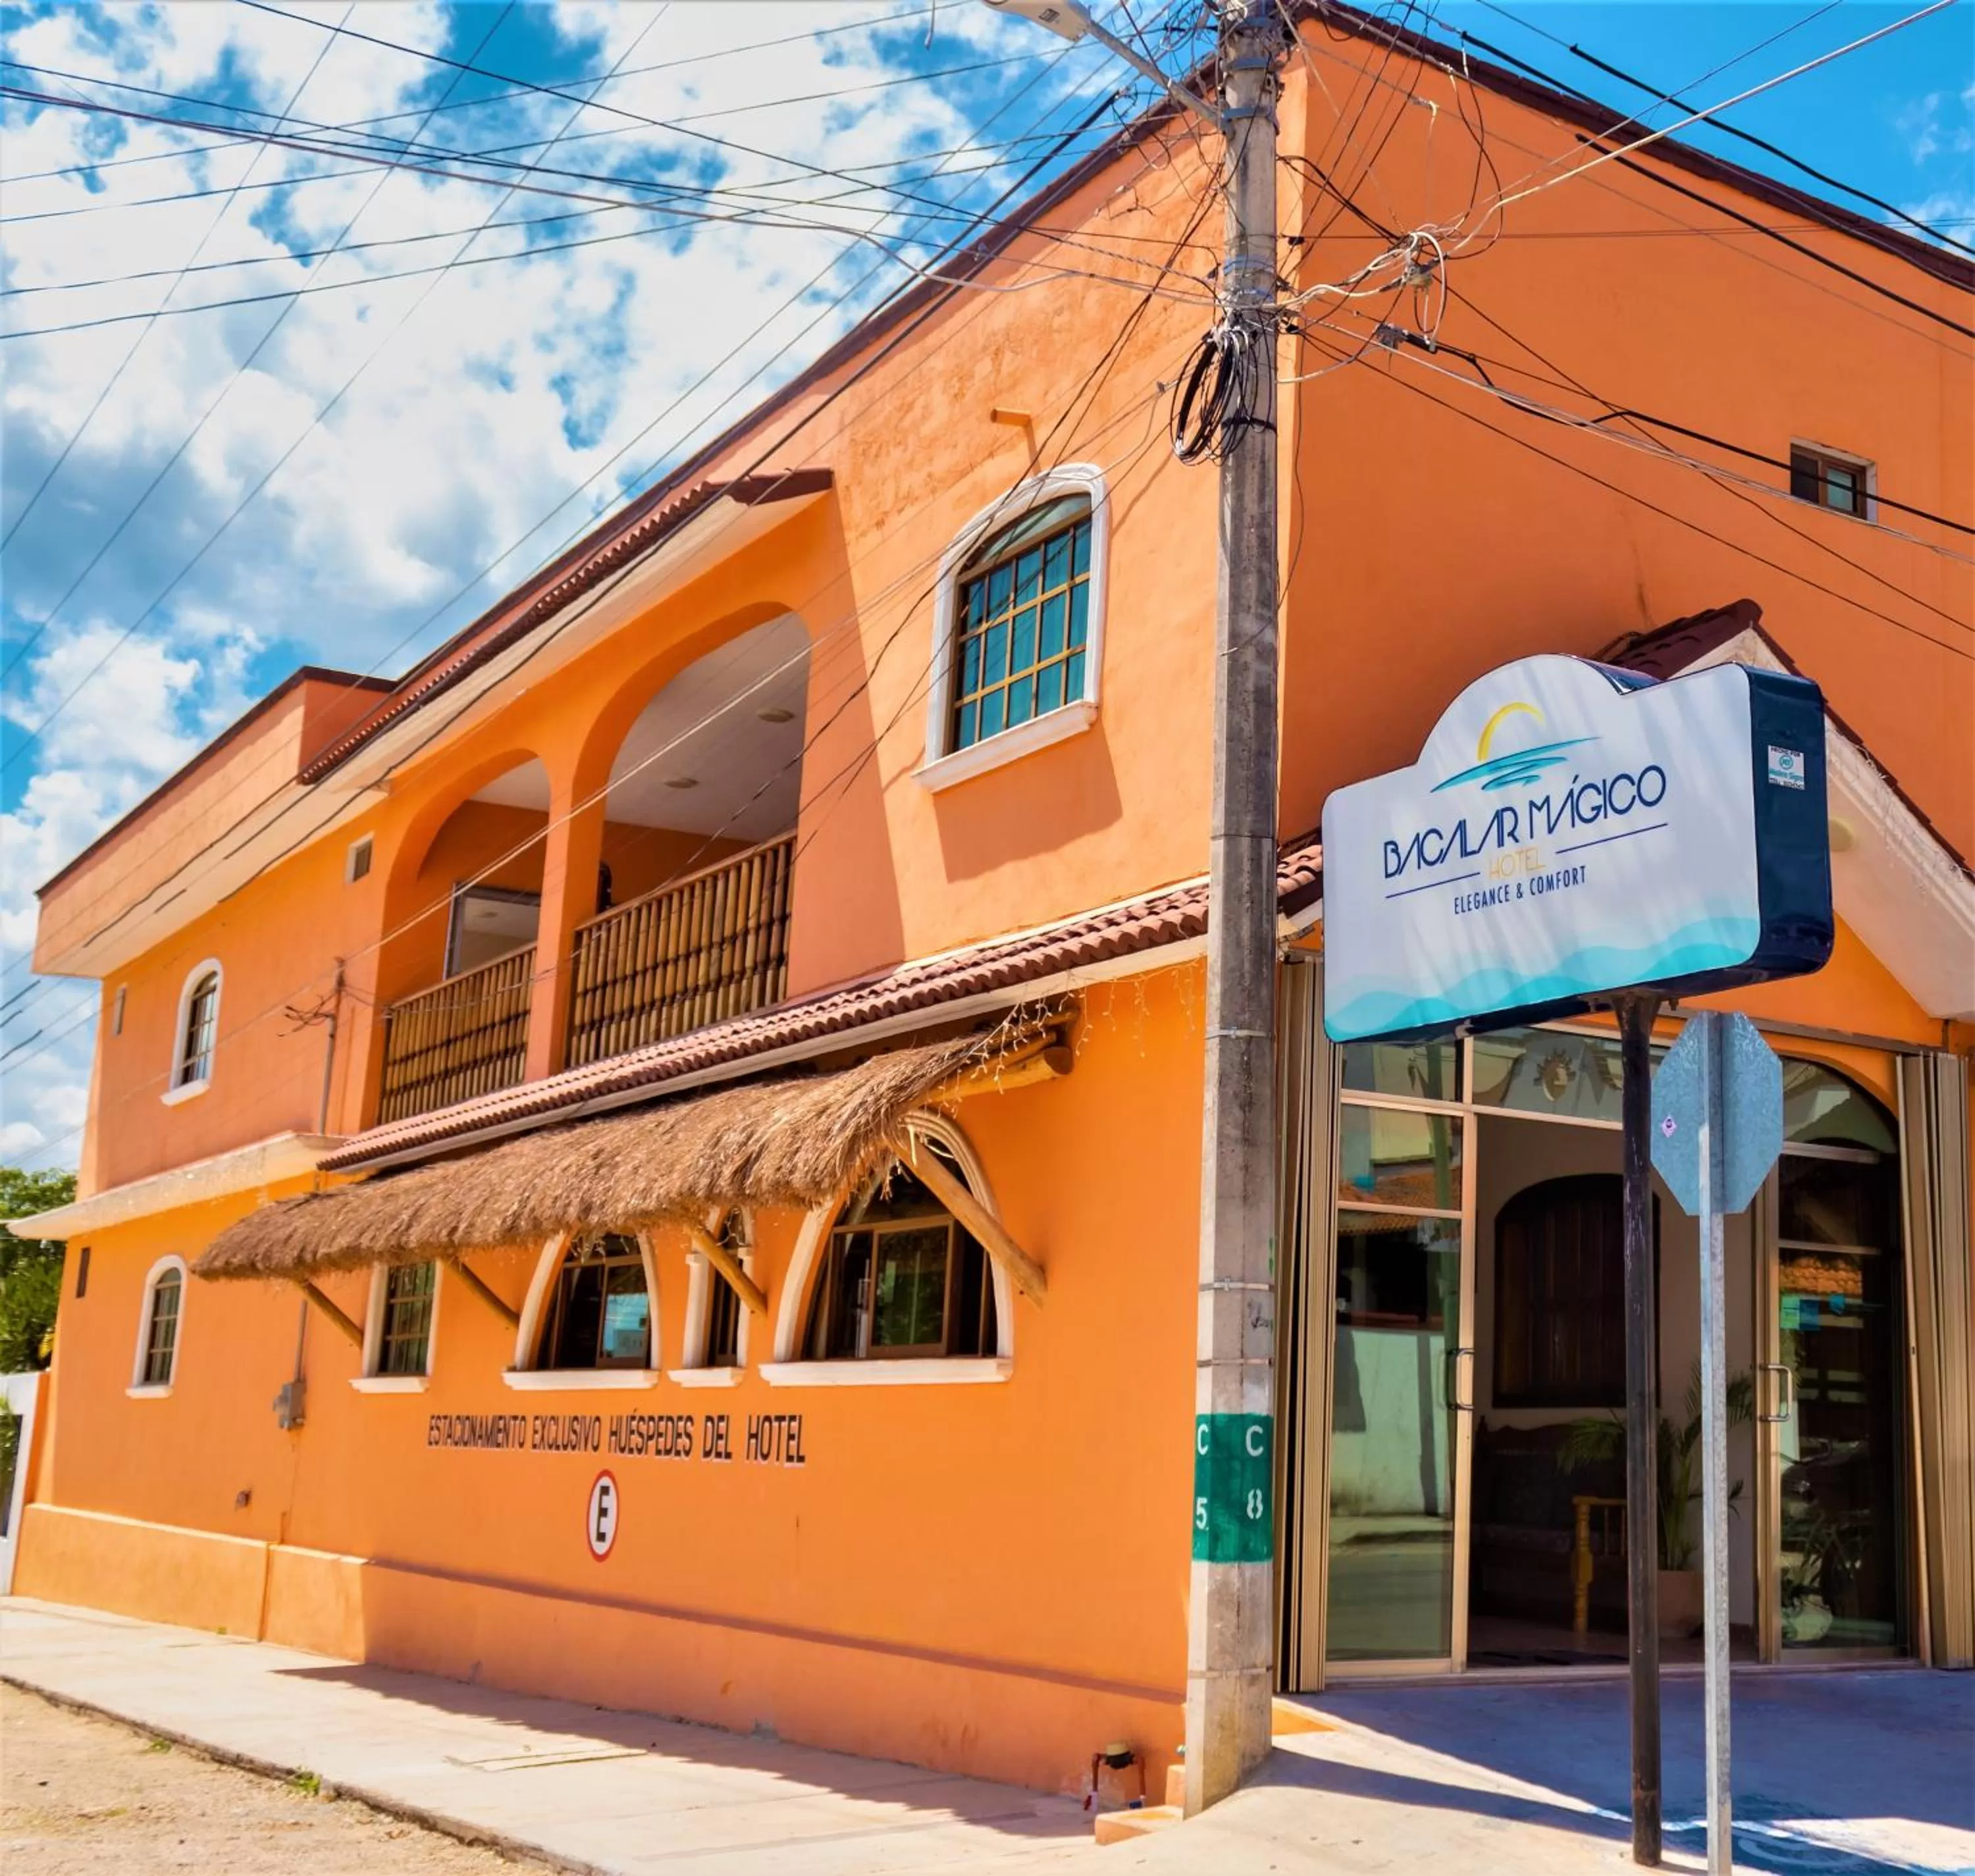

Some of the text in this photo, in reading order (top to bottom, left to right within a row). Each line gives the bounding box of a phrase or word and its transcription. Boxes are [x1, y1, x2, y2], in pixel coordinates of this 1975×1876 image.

[1384, 764, 1667, 879] BACALAR MÁGICO
[1454, 865, 1587, 915] ELEGANCE & COMFORT
[1489, 846, 1546, 879] HOTEL
[427, 1409, 806, 1463] ESTACIONAMIENTO EXCLUSIVO HUÉSPEDES DEL HOTEL
[1195, 1424, 1209, 1530] C 5
[1245, 1425, 1264, 1520] C 8
[595, 1485, 610, 1542] E
